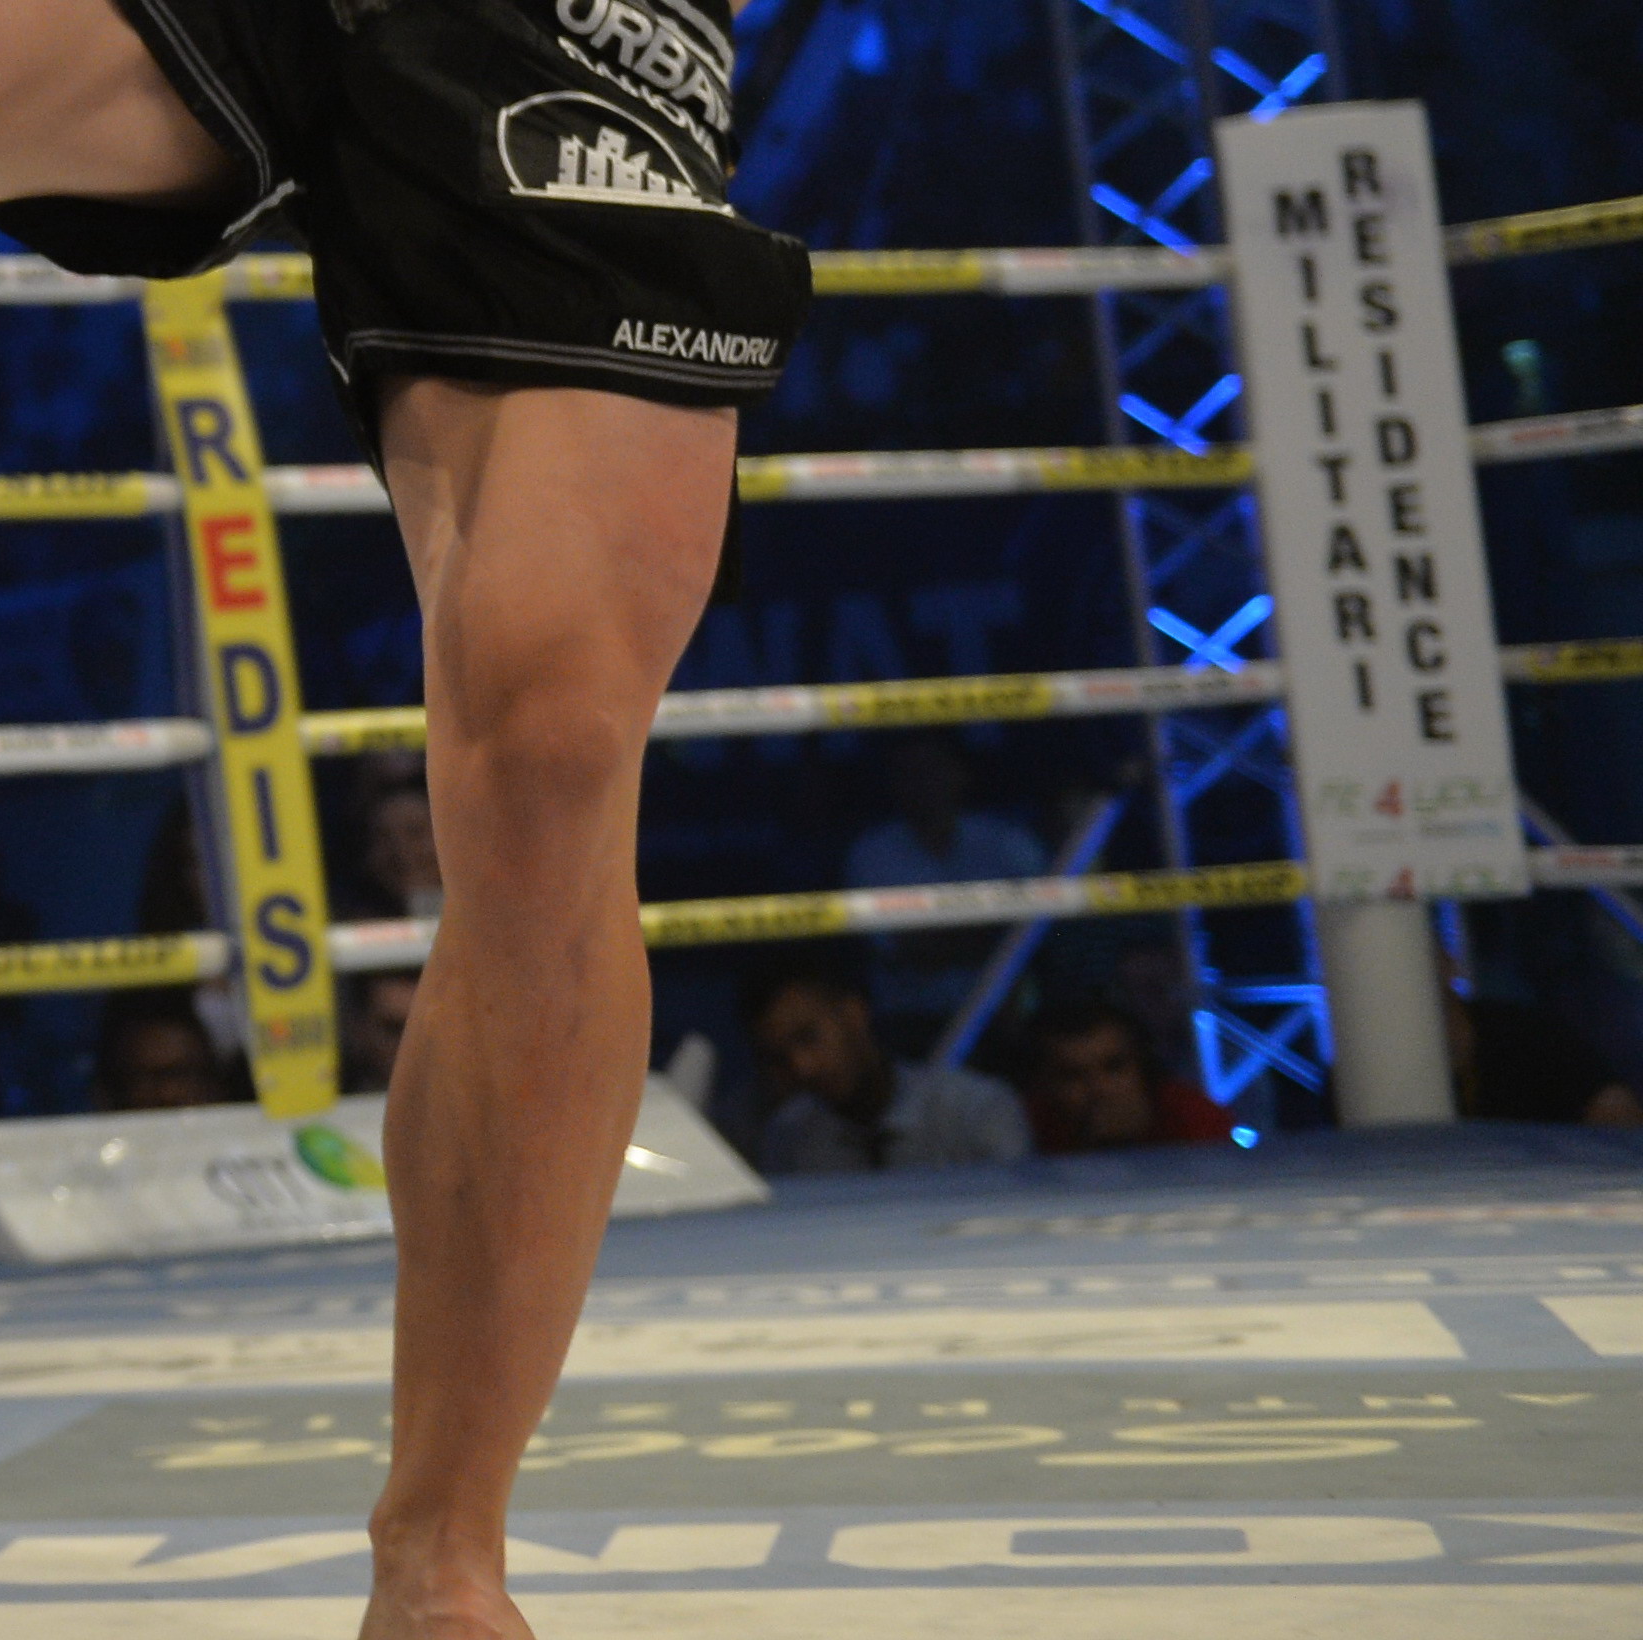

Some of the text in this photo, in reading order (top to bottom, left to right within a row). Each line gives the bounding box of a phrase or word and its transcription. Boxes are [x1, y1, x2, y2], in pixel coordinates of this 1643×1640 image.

[612, 317, 779, 368] ALEXANDRU
[1274, 188, 1376, 712] MILITARI
[1338, 148, 1456, 744] RESIDENCE
[175, 397, 312, 992] REDIS
